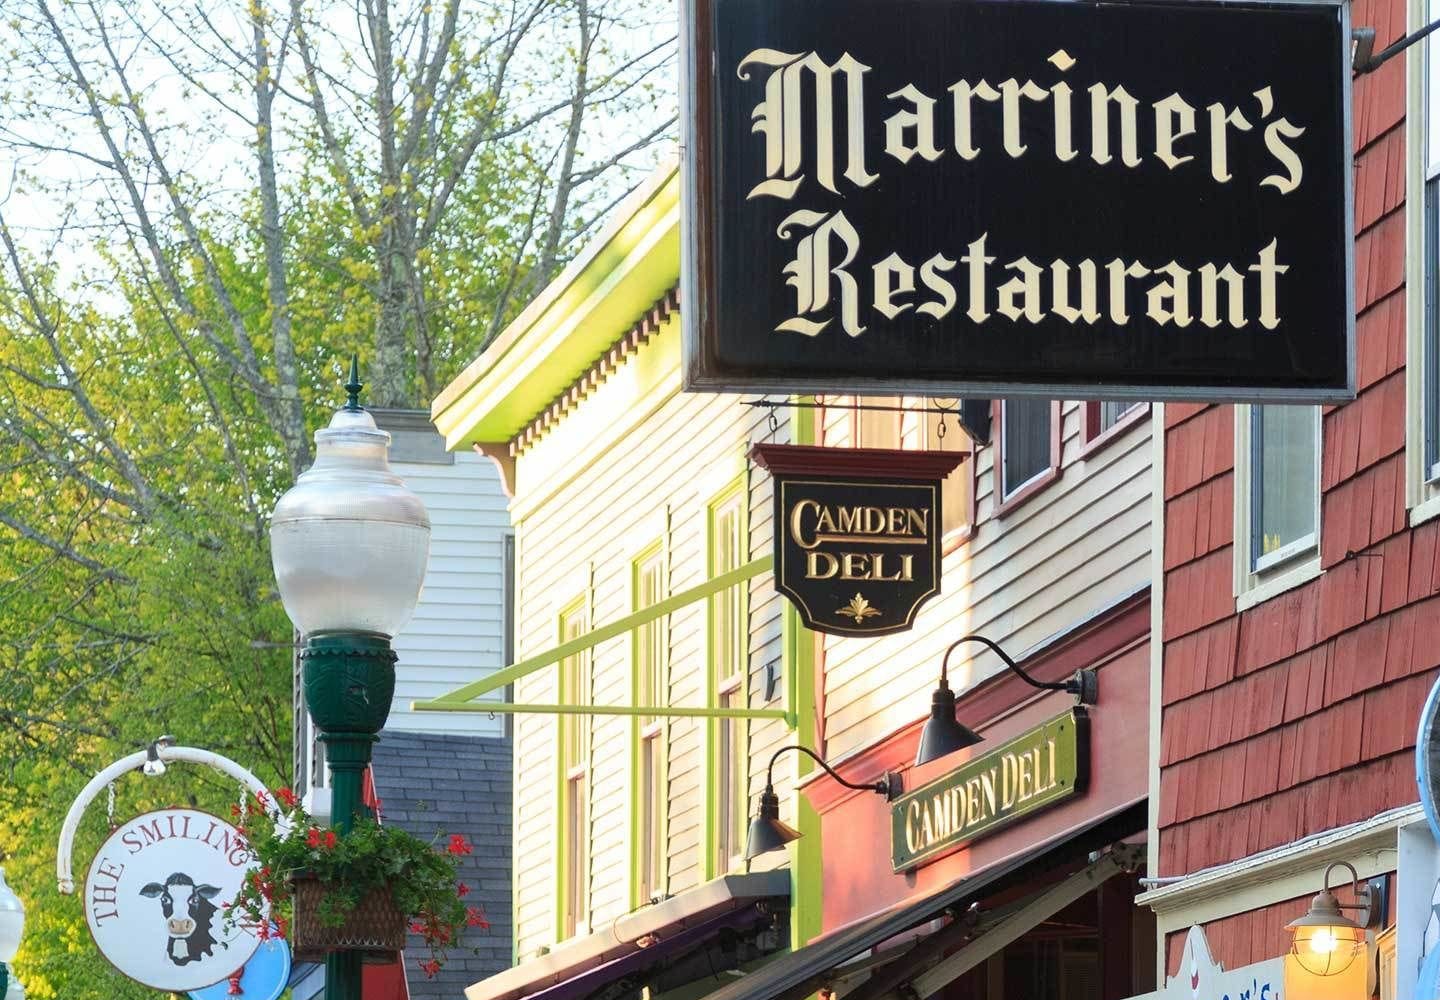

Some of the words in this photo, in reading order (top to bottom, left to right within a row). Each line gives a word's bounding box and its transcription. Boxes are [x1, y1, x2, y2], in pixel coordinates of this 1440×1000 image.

[735, 47, 1306, 201] Marriner's
[773, 208, 1289, 337] Restaurant
[790, 499, 929, 549] CAMDEN
[805, 551, 915, 582] DELI
[905, 765, 999, 855] CAMDEN
[1001, 736, 1057, 812] DELI
[92, 857, 125, 928] THE
[121, 815, 250, 868] SMILING
